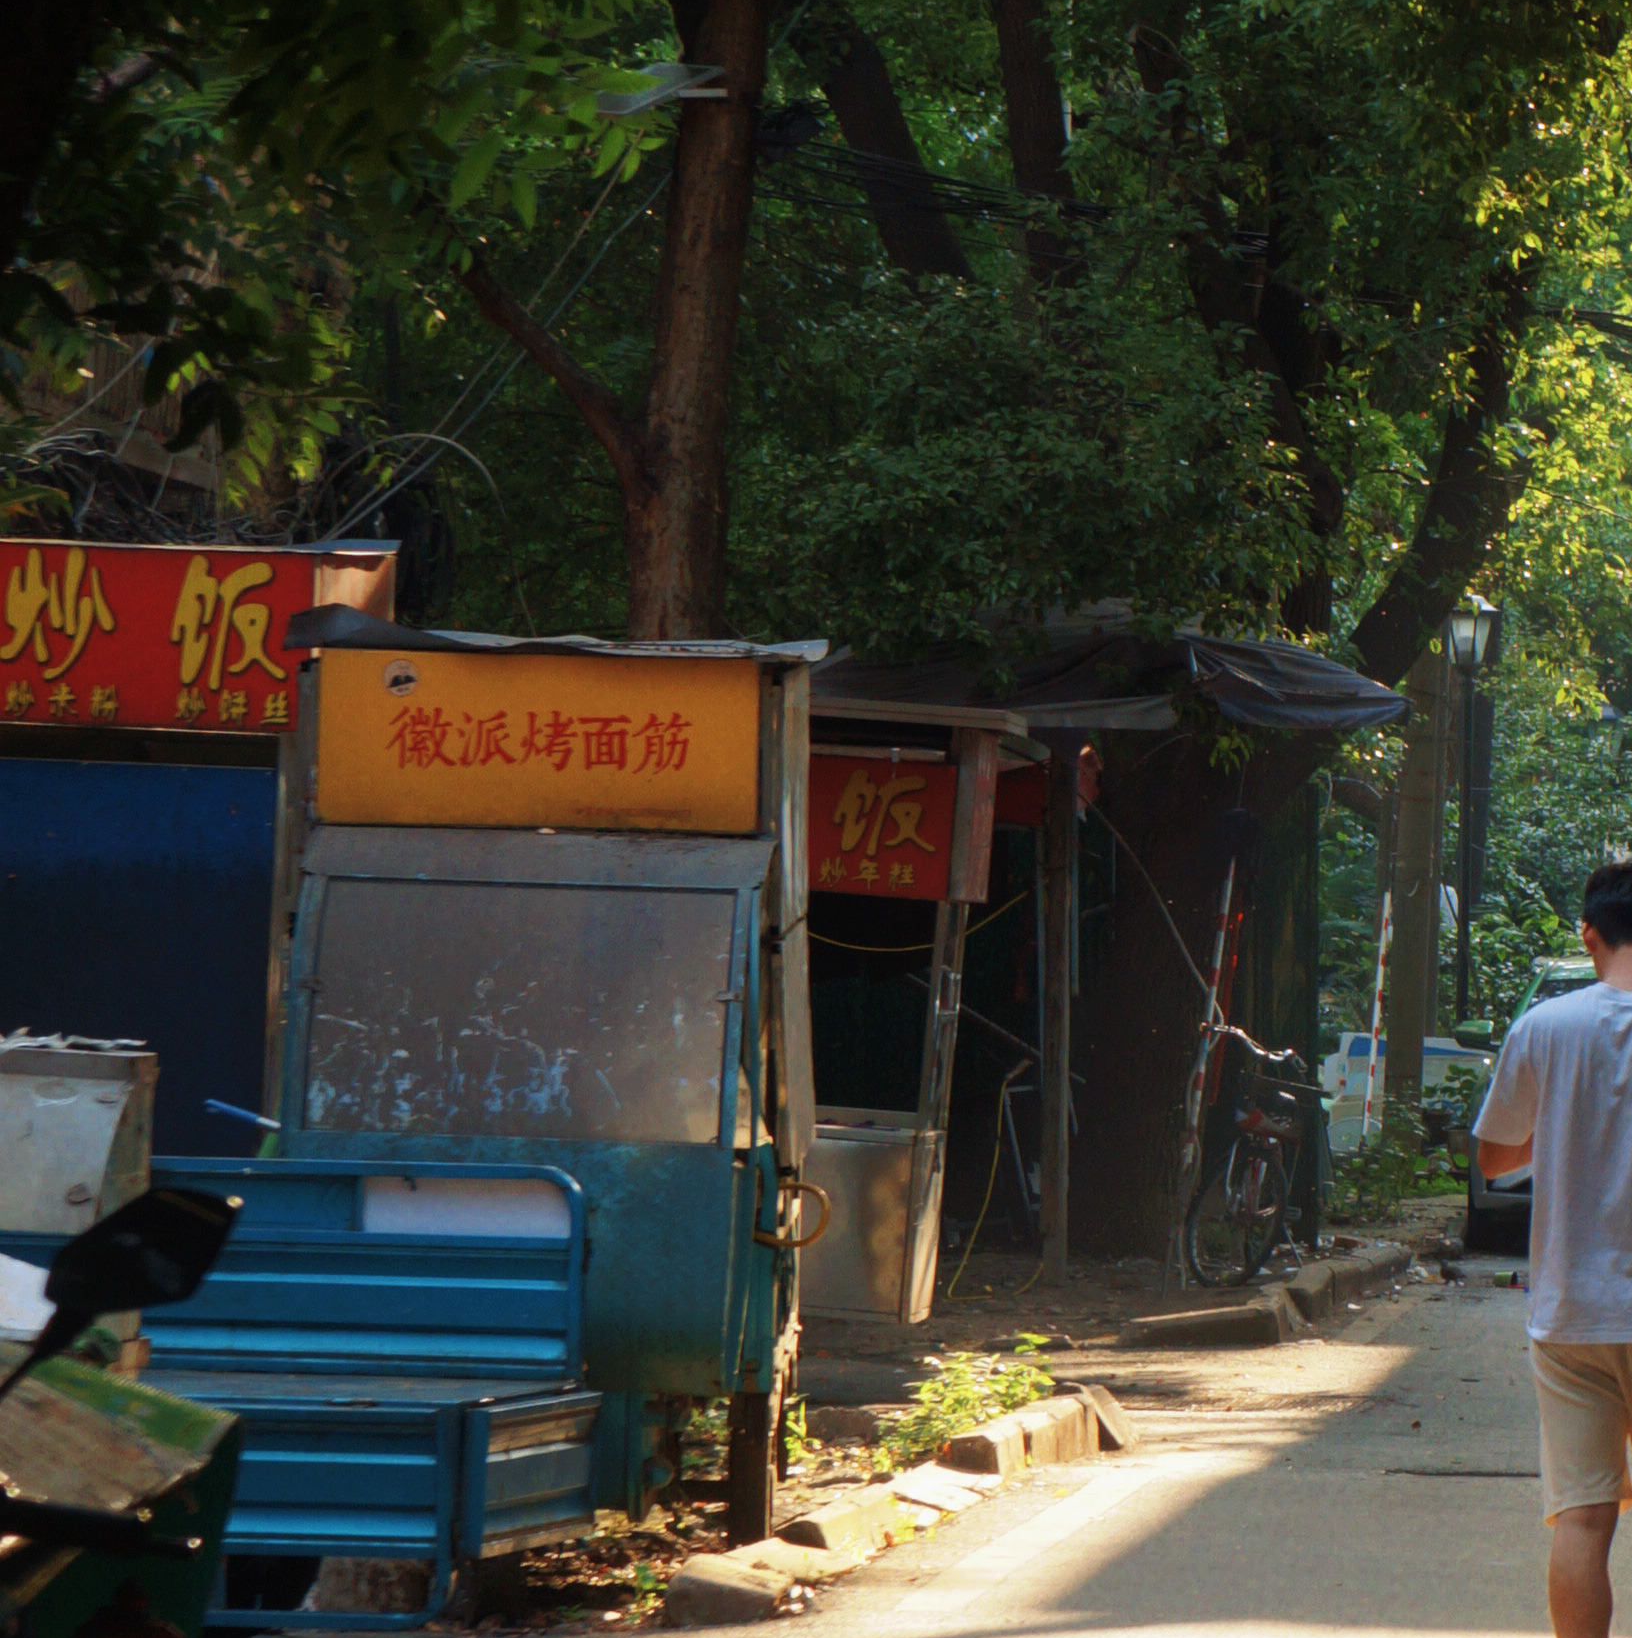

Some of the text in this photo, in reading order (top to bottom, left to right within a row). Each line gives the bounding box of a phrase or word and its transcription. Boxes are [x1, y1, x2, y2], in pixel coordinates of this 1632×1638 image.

[0, 547, 287, 691] 炒饭
[385, 705, 693, 775] 徽派烤面筋
[833, 769, 936, 856] 饭
[818, 856, 916, 892] 炒年糕
